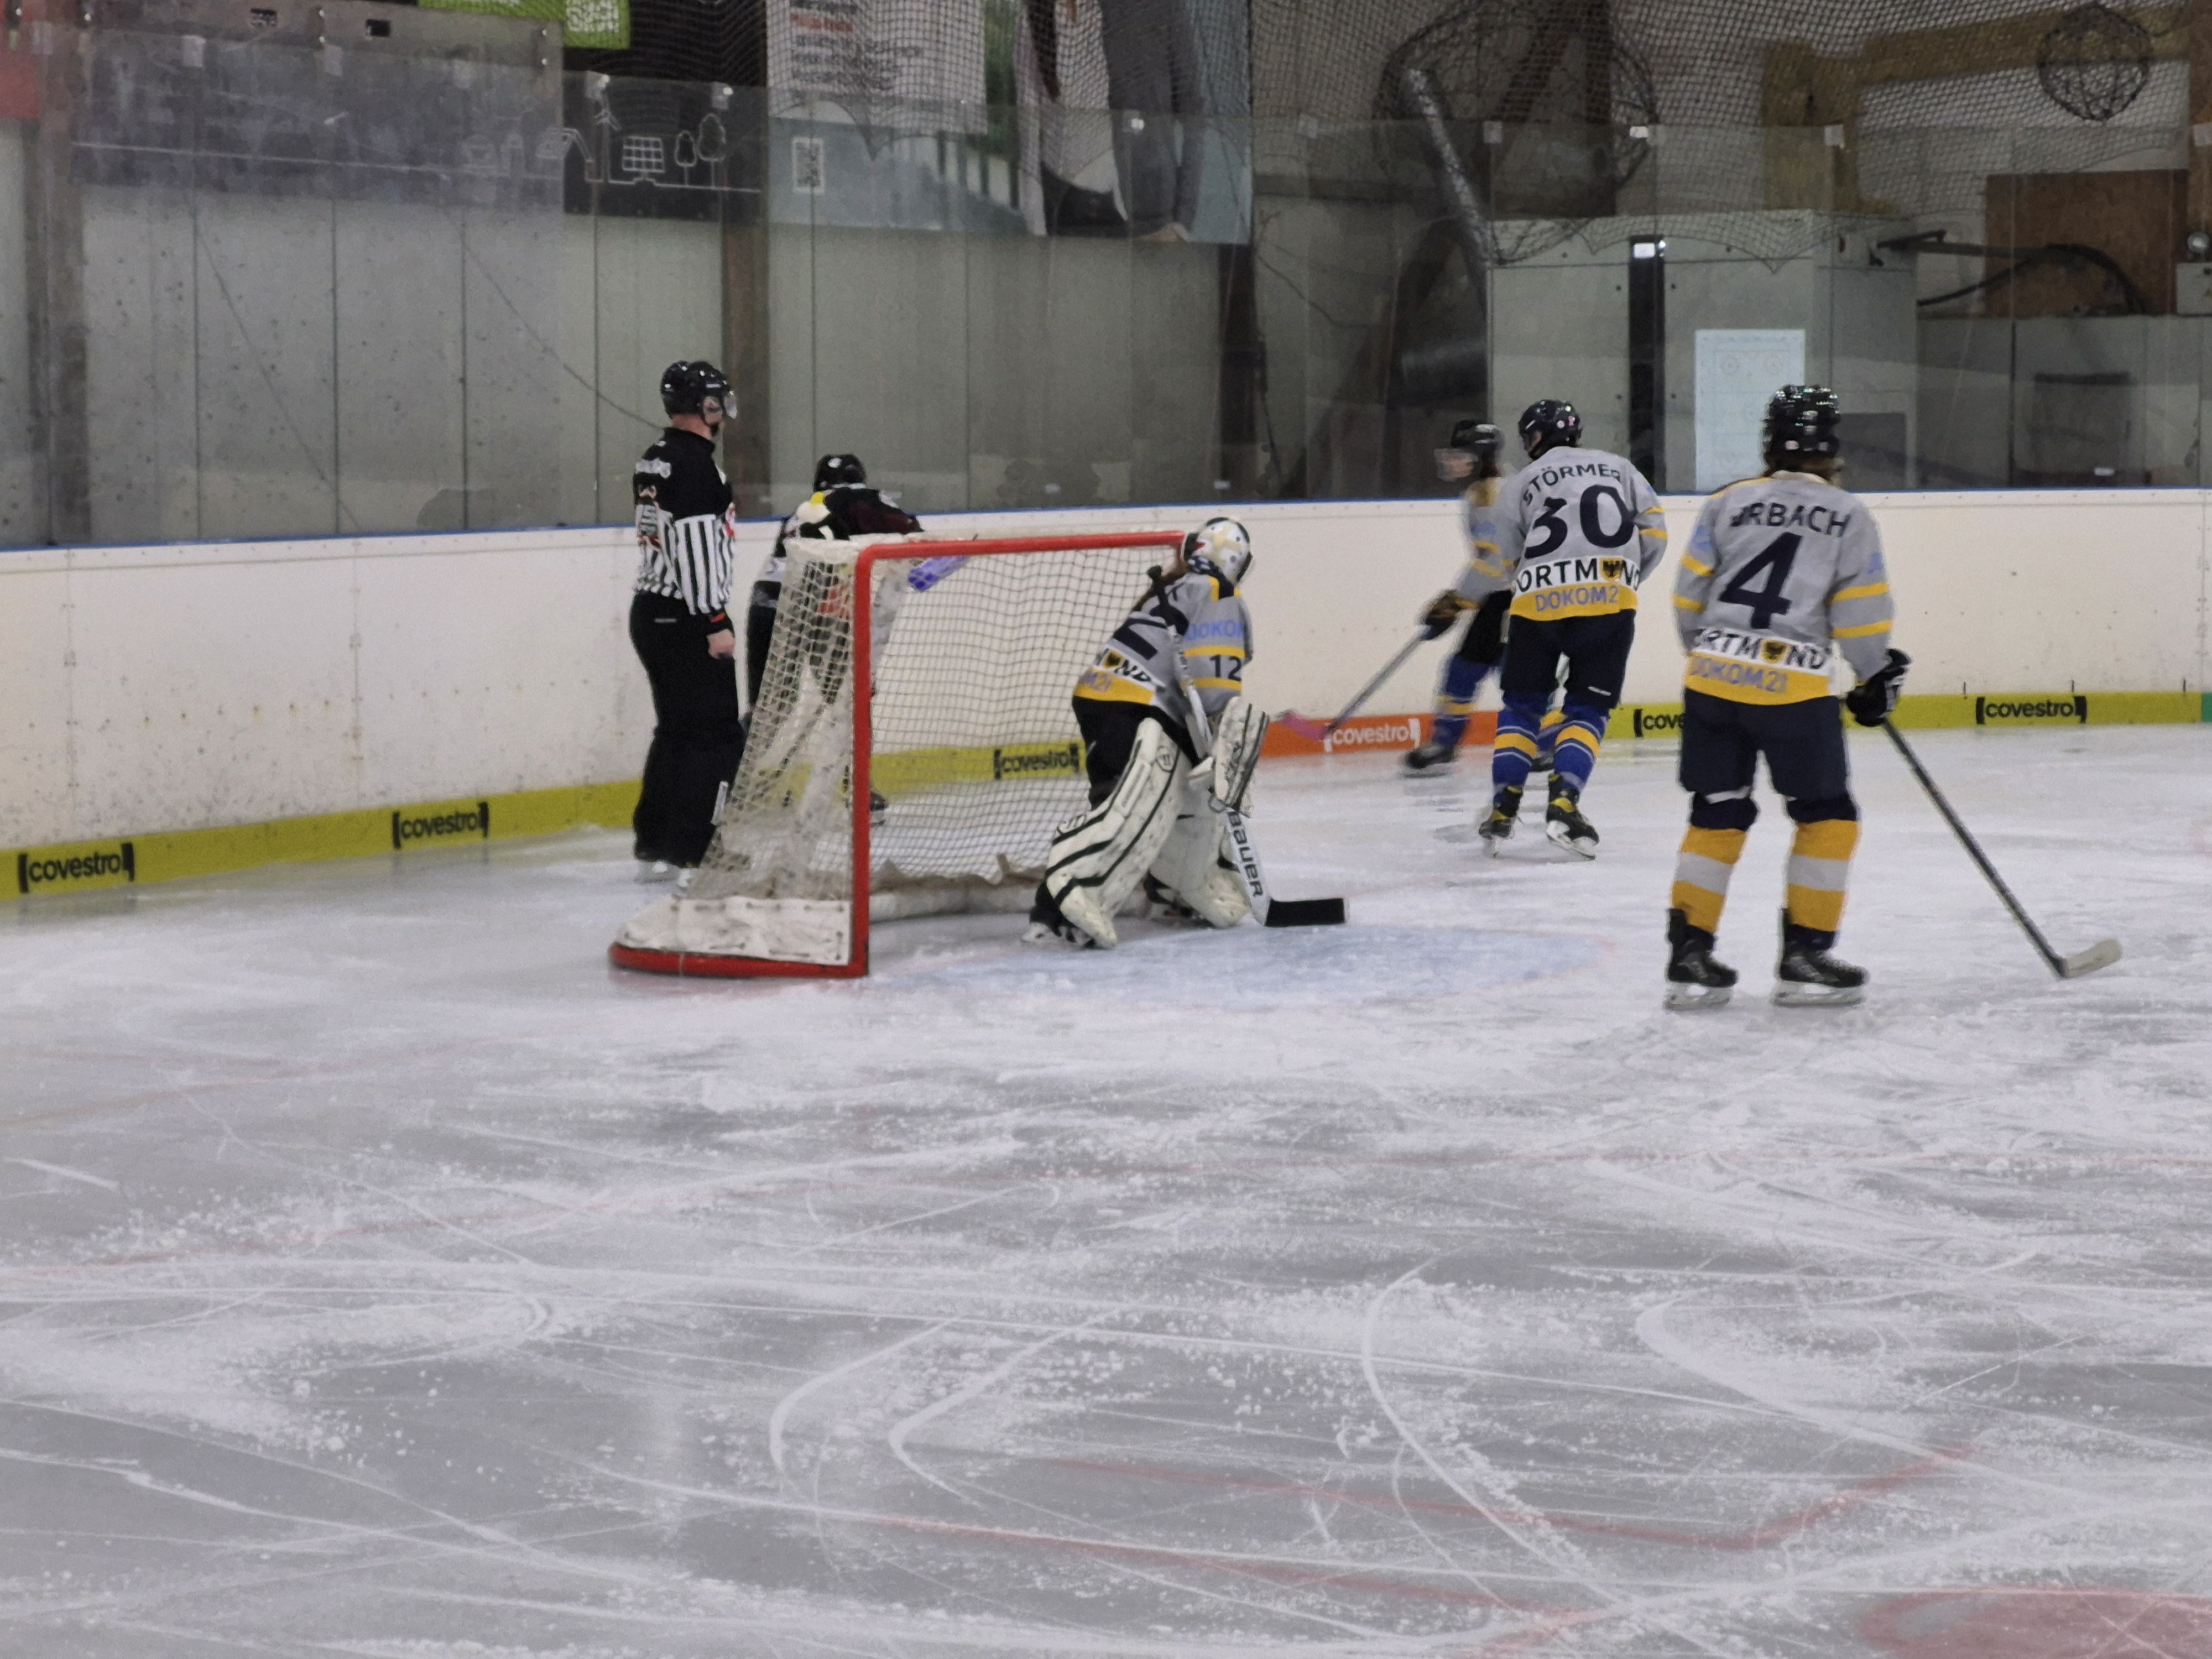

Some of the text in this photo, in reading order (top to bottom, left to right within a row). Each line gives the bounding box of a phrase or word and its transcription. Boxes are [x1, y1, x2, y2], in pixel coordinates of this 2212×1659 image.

[1522, 463, 1621, 507] STÖRMER
[1524, 483, 1635, 560] 30
[1718, 531, 1804, 629] 4
[1208, 654, 1243, 682] 12
[1984, 698, 2075, 718] covestro
[1332, 723, 1411, 745] covestro
[1001, 749, 1071, 773] covestro
[399, 810, 479, 841] covestro
[28, 850, 123, 883] covestro
